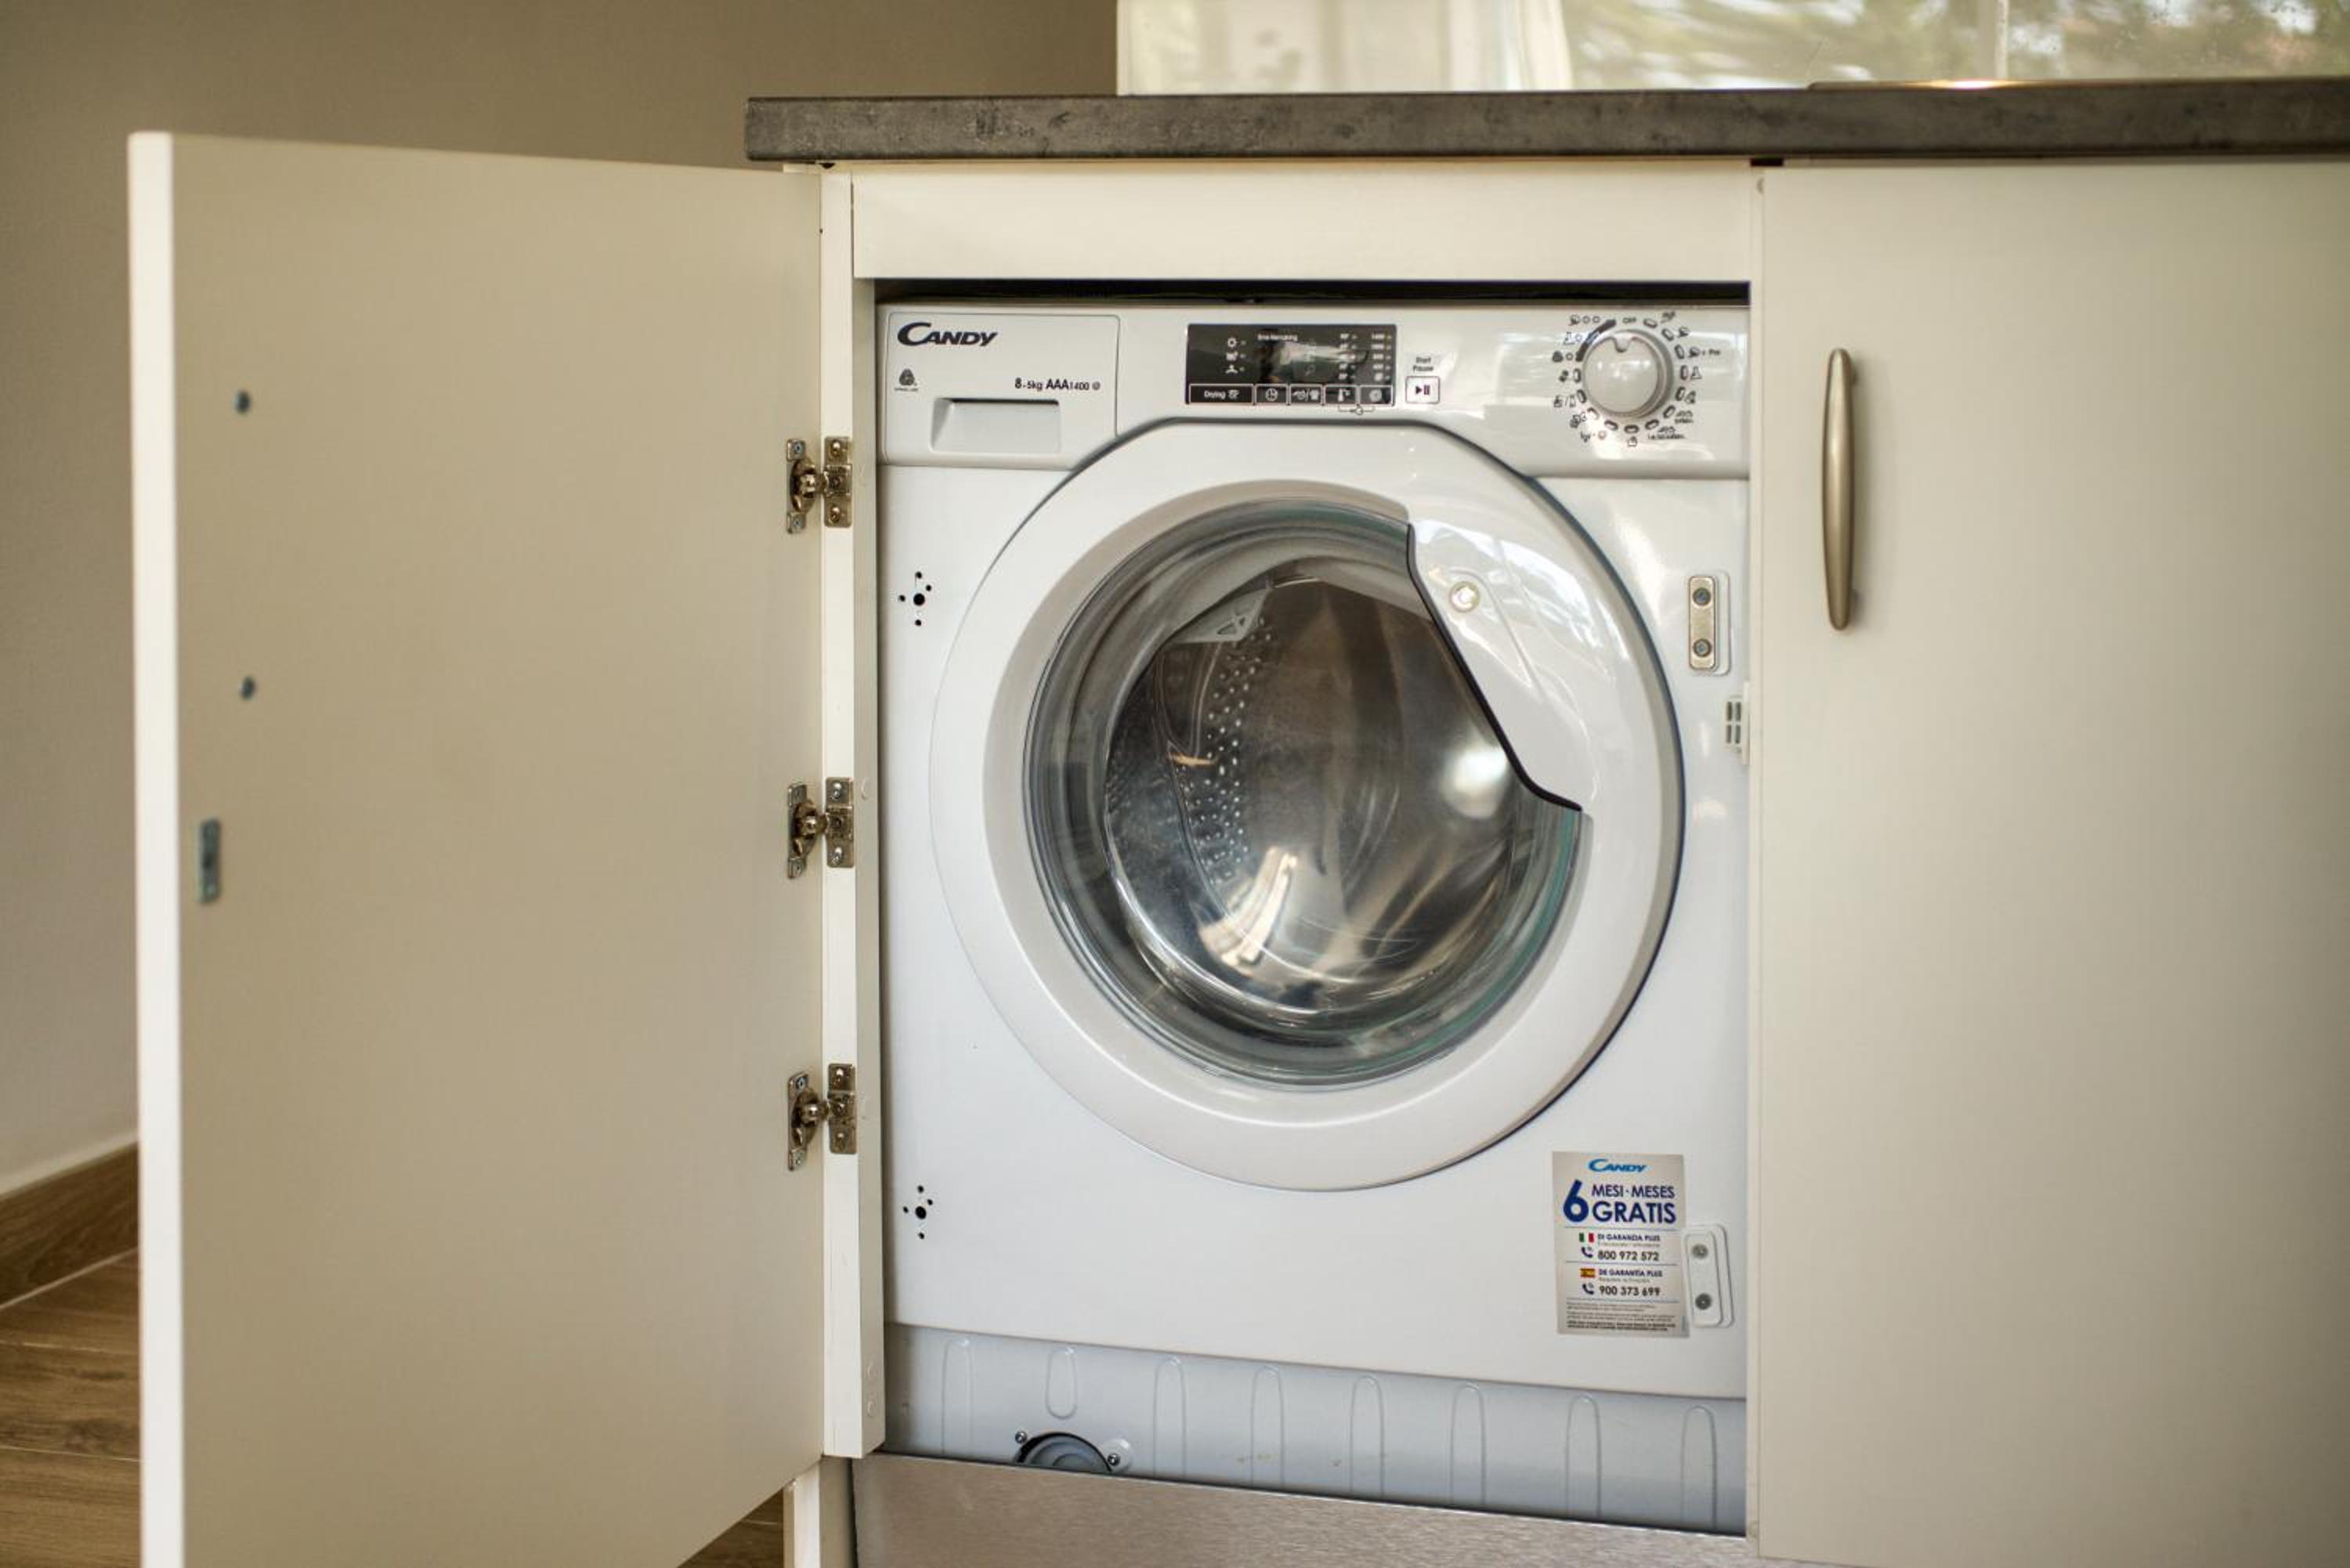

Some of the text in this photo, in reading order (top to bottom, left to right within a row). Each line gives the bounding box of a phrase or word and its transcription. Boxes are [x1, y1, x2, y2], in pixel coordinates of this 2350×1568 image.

[1591, 1184, 1676, 1199] MESI MESES
[1563, 1179, 1589, 1223] 6
[1592, 1201, 1676, 1224] GRATIS
[1619, 1251, 1638, 1261] 972
[1641, 1251, 1660, 1261] 572
[1599, 1285, 1618, 1295] 900
[1620, 1286, 1640, 1296] 373
